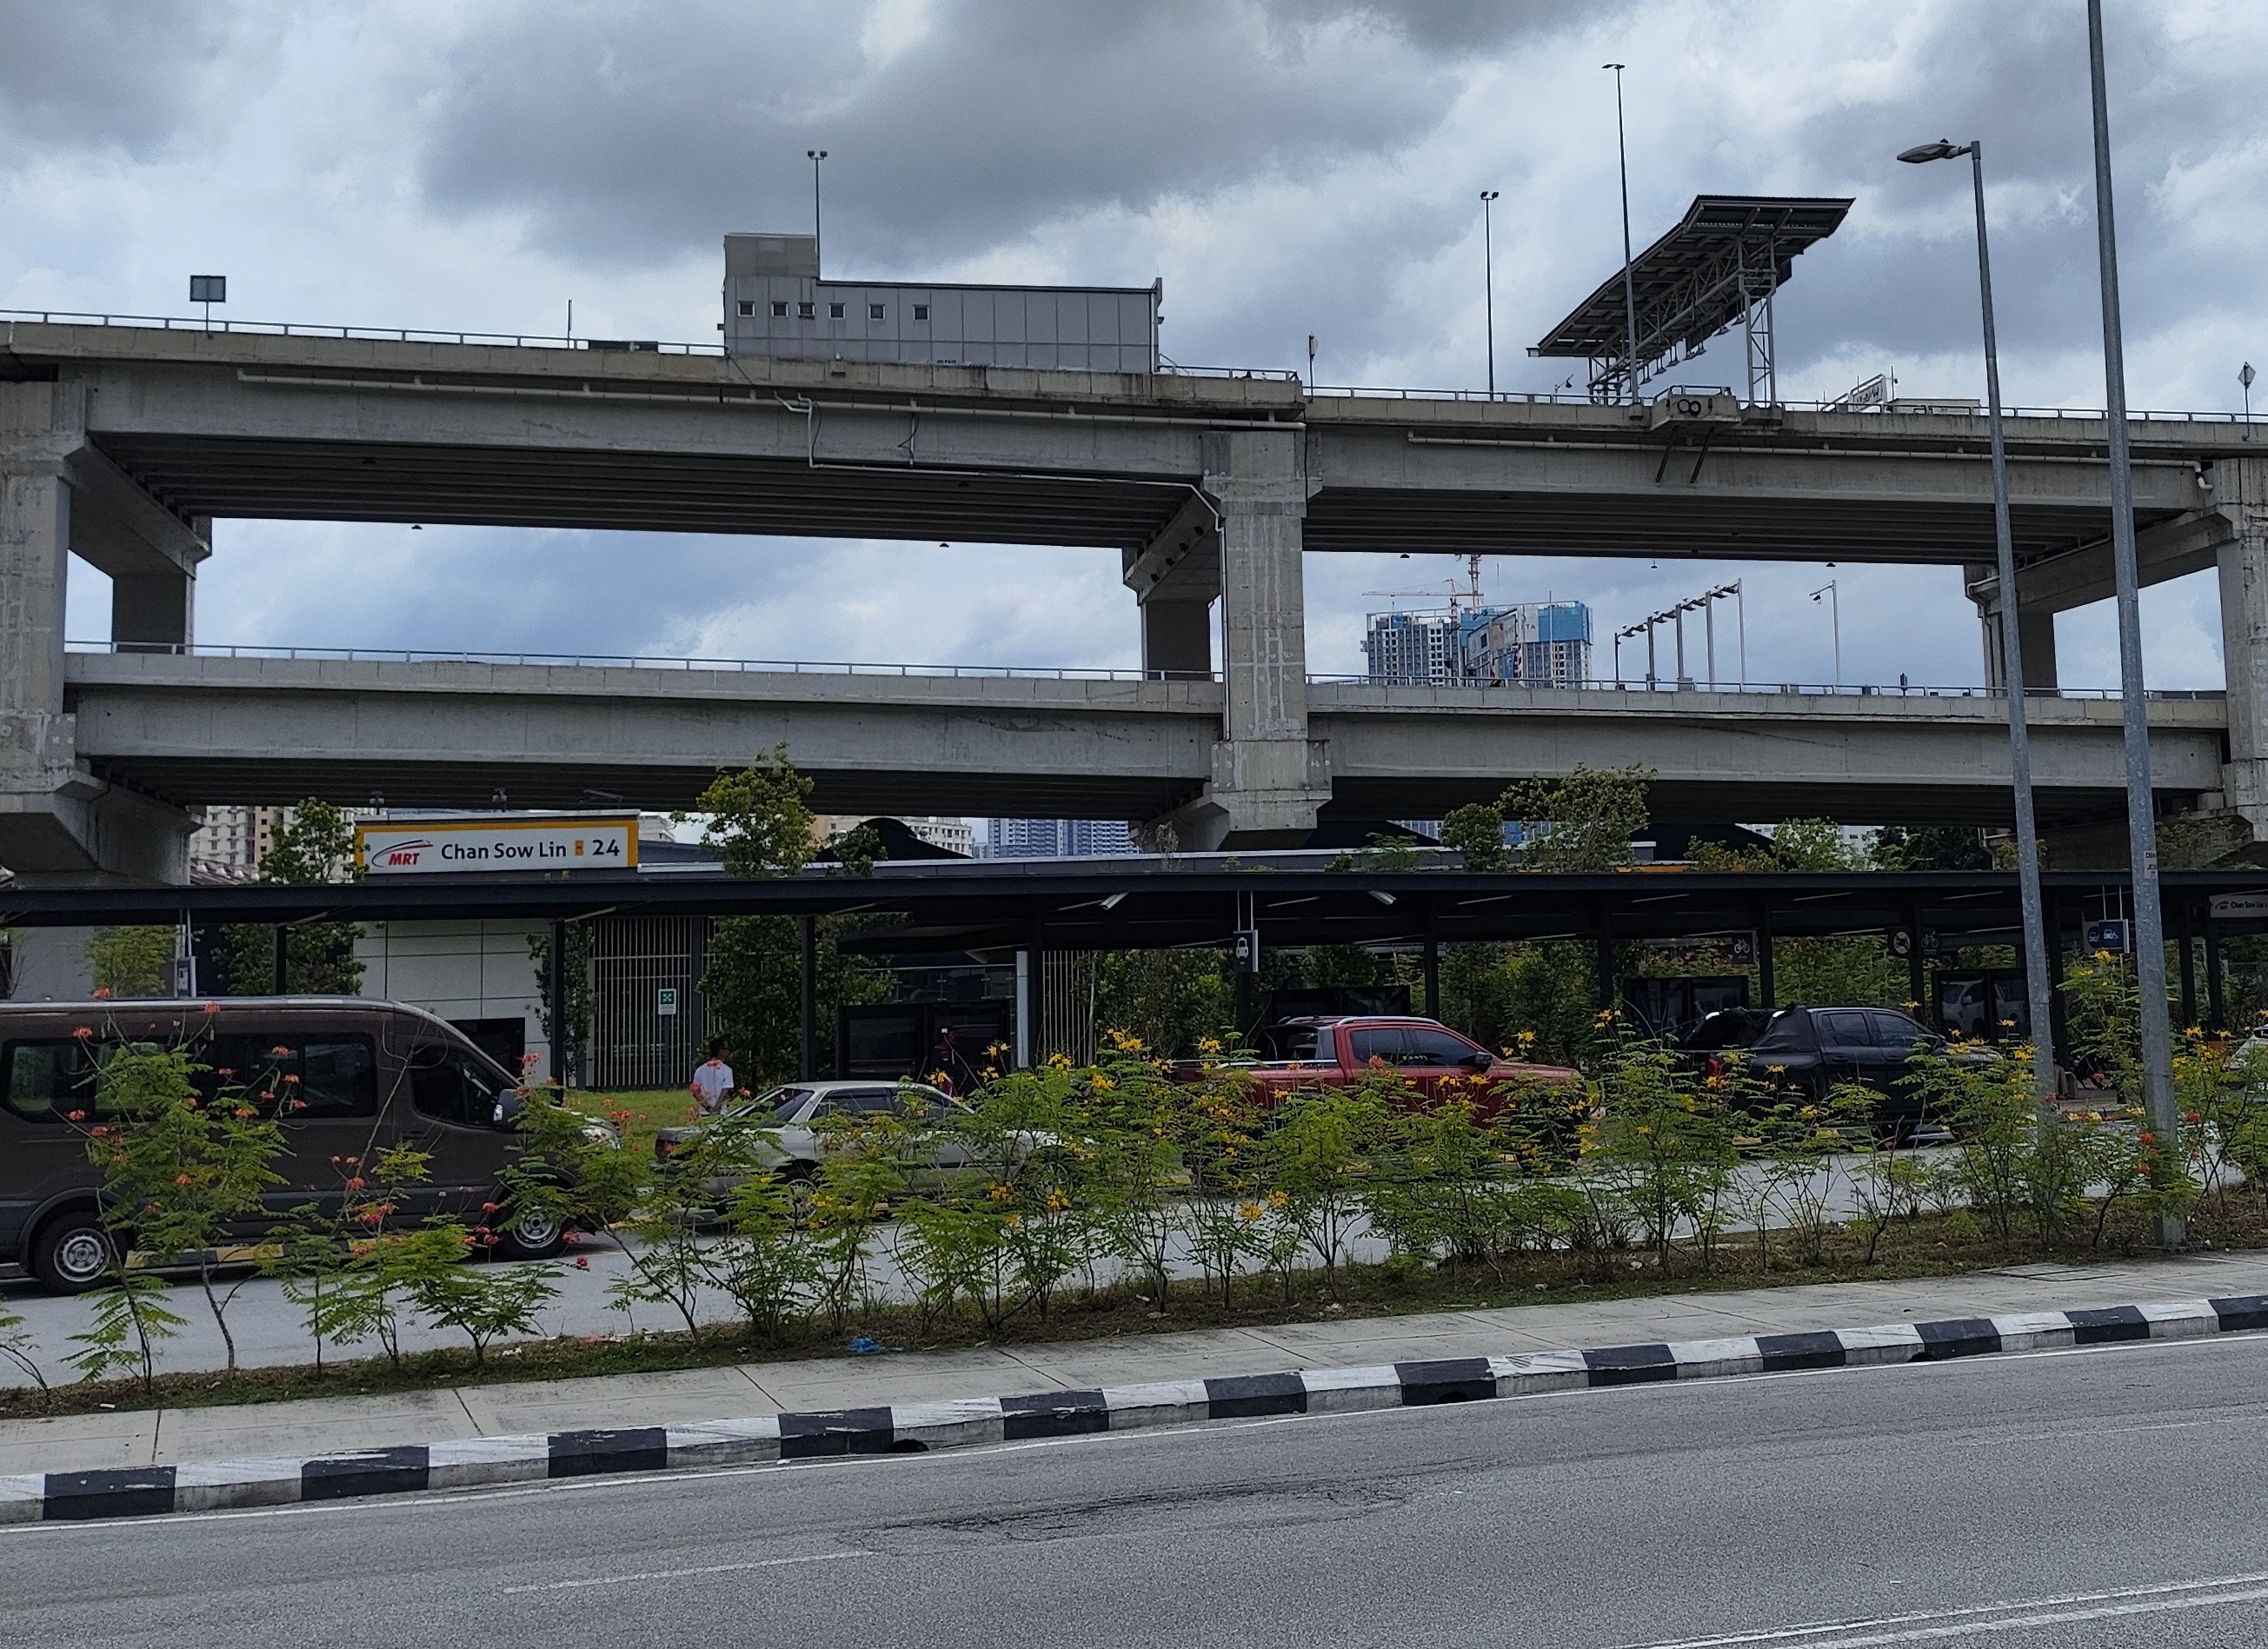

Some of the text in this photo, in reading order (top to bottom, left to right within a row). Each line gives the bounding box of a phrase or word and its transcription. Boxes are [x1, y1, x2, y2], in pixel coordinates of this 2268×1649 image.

[441, 839, 621, 860] Chan Sow Lin 24
[389, 853, 420, 866] MRT
